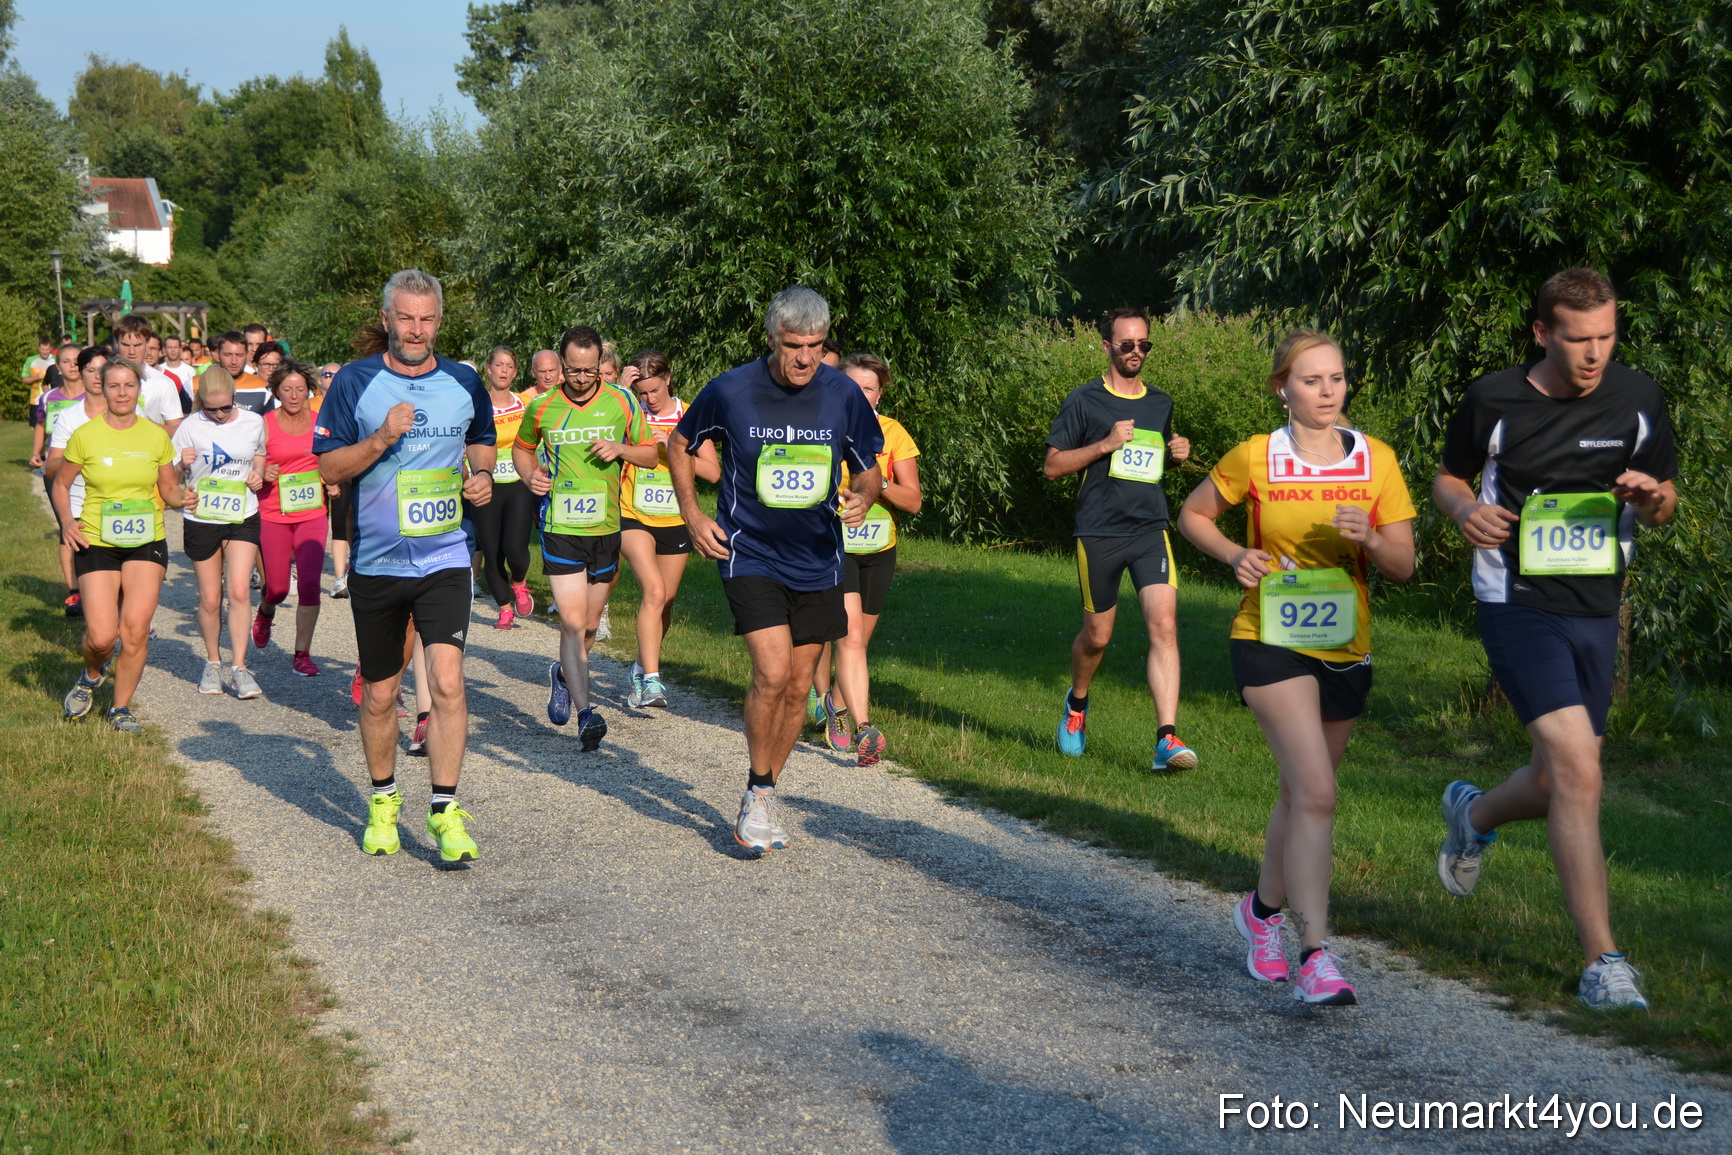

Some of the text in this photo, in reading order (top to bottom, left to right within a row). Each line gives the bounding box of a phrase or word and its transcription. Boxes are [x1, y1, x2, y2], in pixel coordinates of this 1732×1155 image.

[494, 418, 505, 426] AX
[548, 425, 616, 446] BOCK
[749, 426, 833, 441] EURO POLES
[408, 443, 431, 452] TEAM
[1586, 440, 1624, 448] PFLEIDERER
[1122, 448, 1154, 468] 837
[401, 474, 422, 483] 2013
[770, 469, 815, 491] 383
[289, 486, 315, 502] 349
[644, 488, 675, 504] 867
[1267, 485, 1372, 502] MAX BÖGL
[201, 494, 241, 512] 1478
[408, 498, 457, 524] 6099
[563, 498, 597, 514] 142
[112, 518, 146, 535] 643
[846, 524, 881, 540] 947
[1530, 524, 1606, 552] 1080
[1279, 601, 1338, 628] 922
